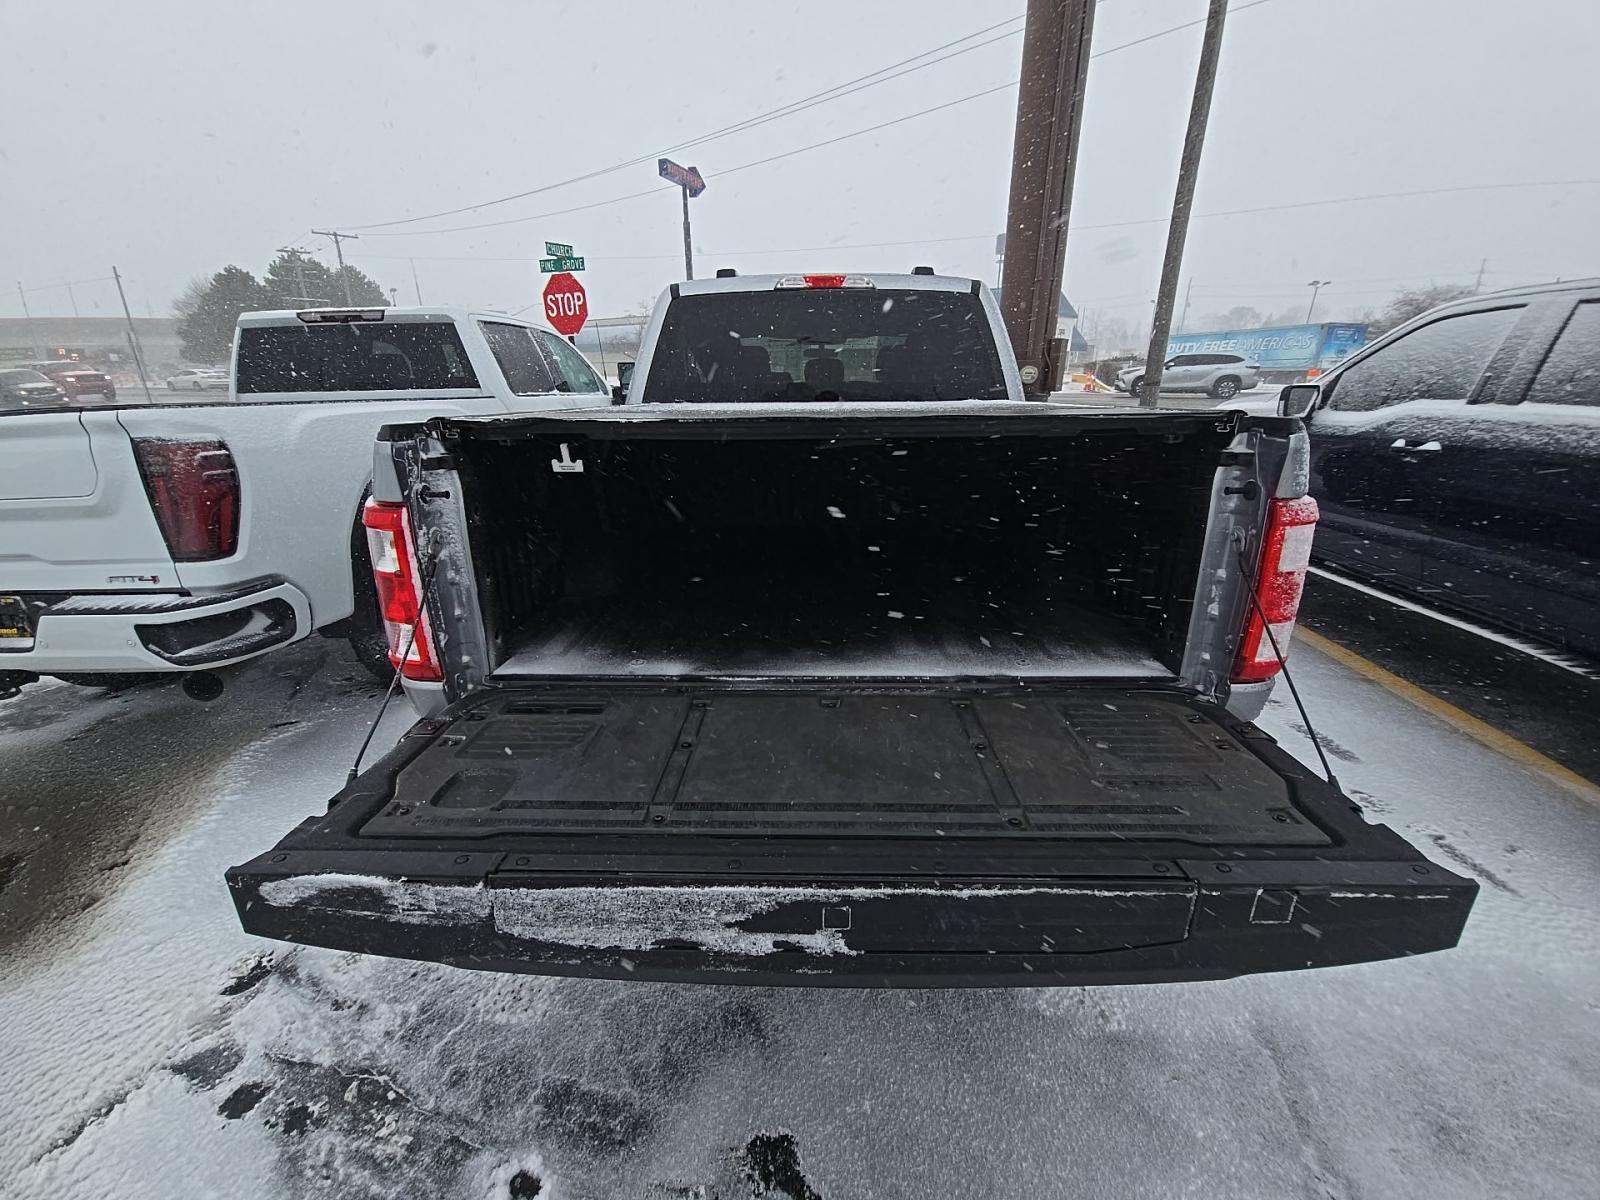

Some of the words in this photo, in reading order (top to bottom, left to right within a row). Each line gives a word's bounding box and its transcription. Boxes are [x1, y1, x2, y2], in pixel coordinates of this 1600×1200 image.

[547, 244, 573, 257] CHURCH
[540, 260, 555, 271] PINE
[562, 258, 584, 270] GROVE
[546, 292, 583, 316] STOP
[1168, 342, 1200, 353] DUTY
[1203, 340, 1237, 351] FREE
[1237, 334, 1314, 351] AMERICAS
